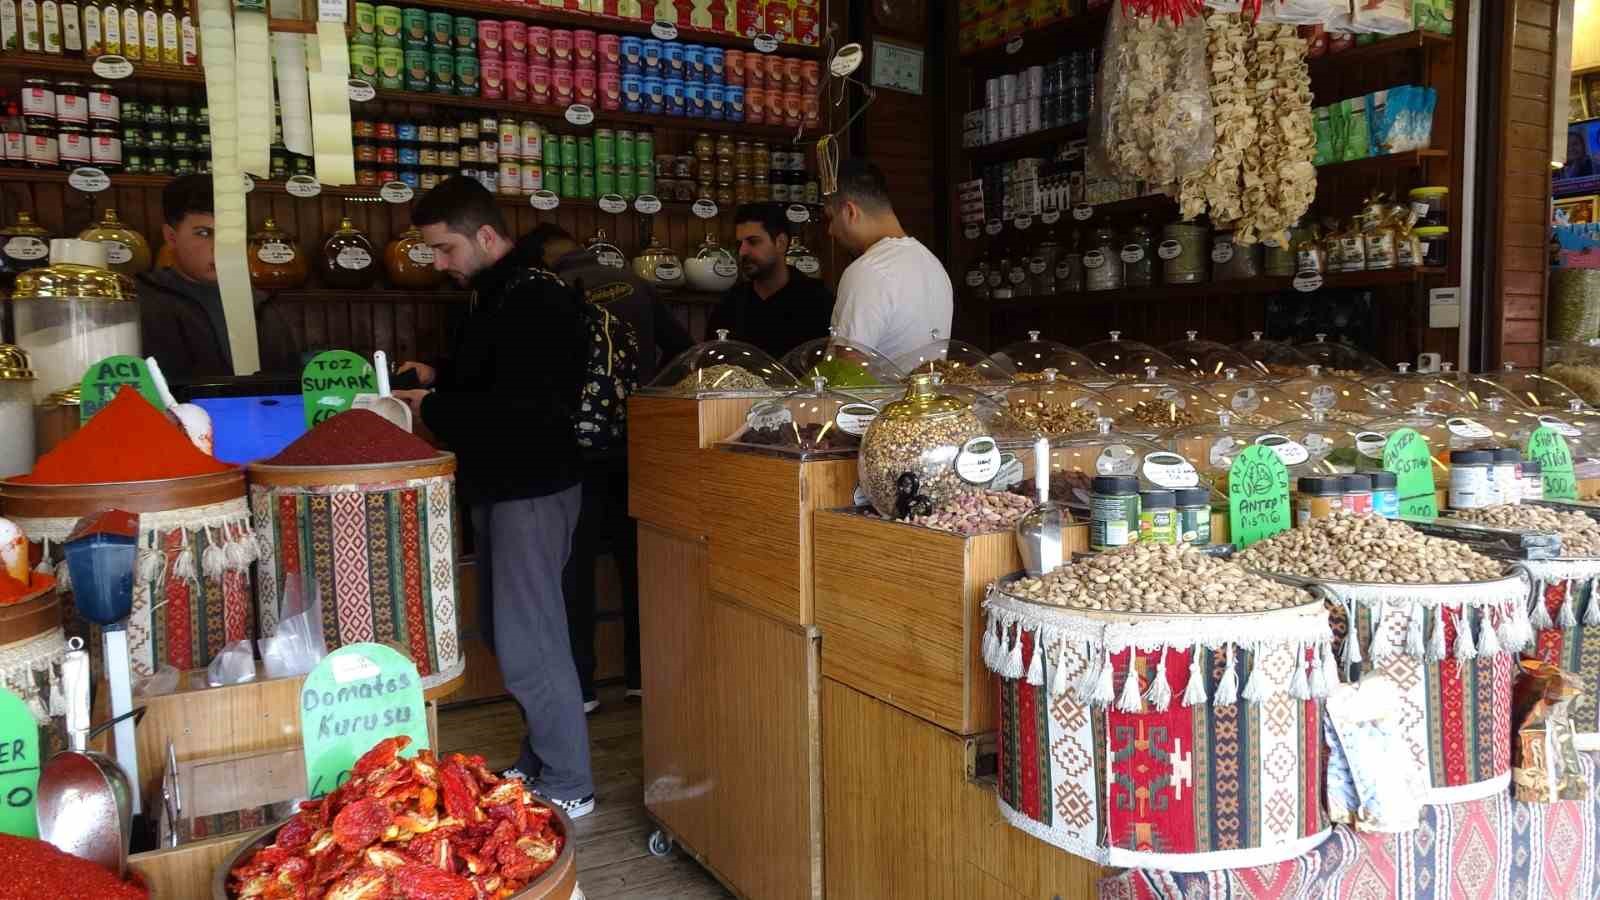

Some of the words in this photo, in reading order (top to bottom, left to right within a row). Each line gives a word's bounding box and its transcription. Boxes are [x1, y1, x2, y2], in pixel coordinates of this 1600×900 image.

[97, 362, 140, 380] ACI
[313, 358, 353, 371] TOZ
[303, 374, 373, 392] SUMAK
[1239, 497, 1278, 515] ANTEP
[0, 786, 33, 808] 0
